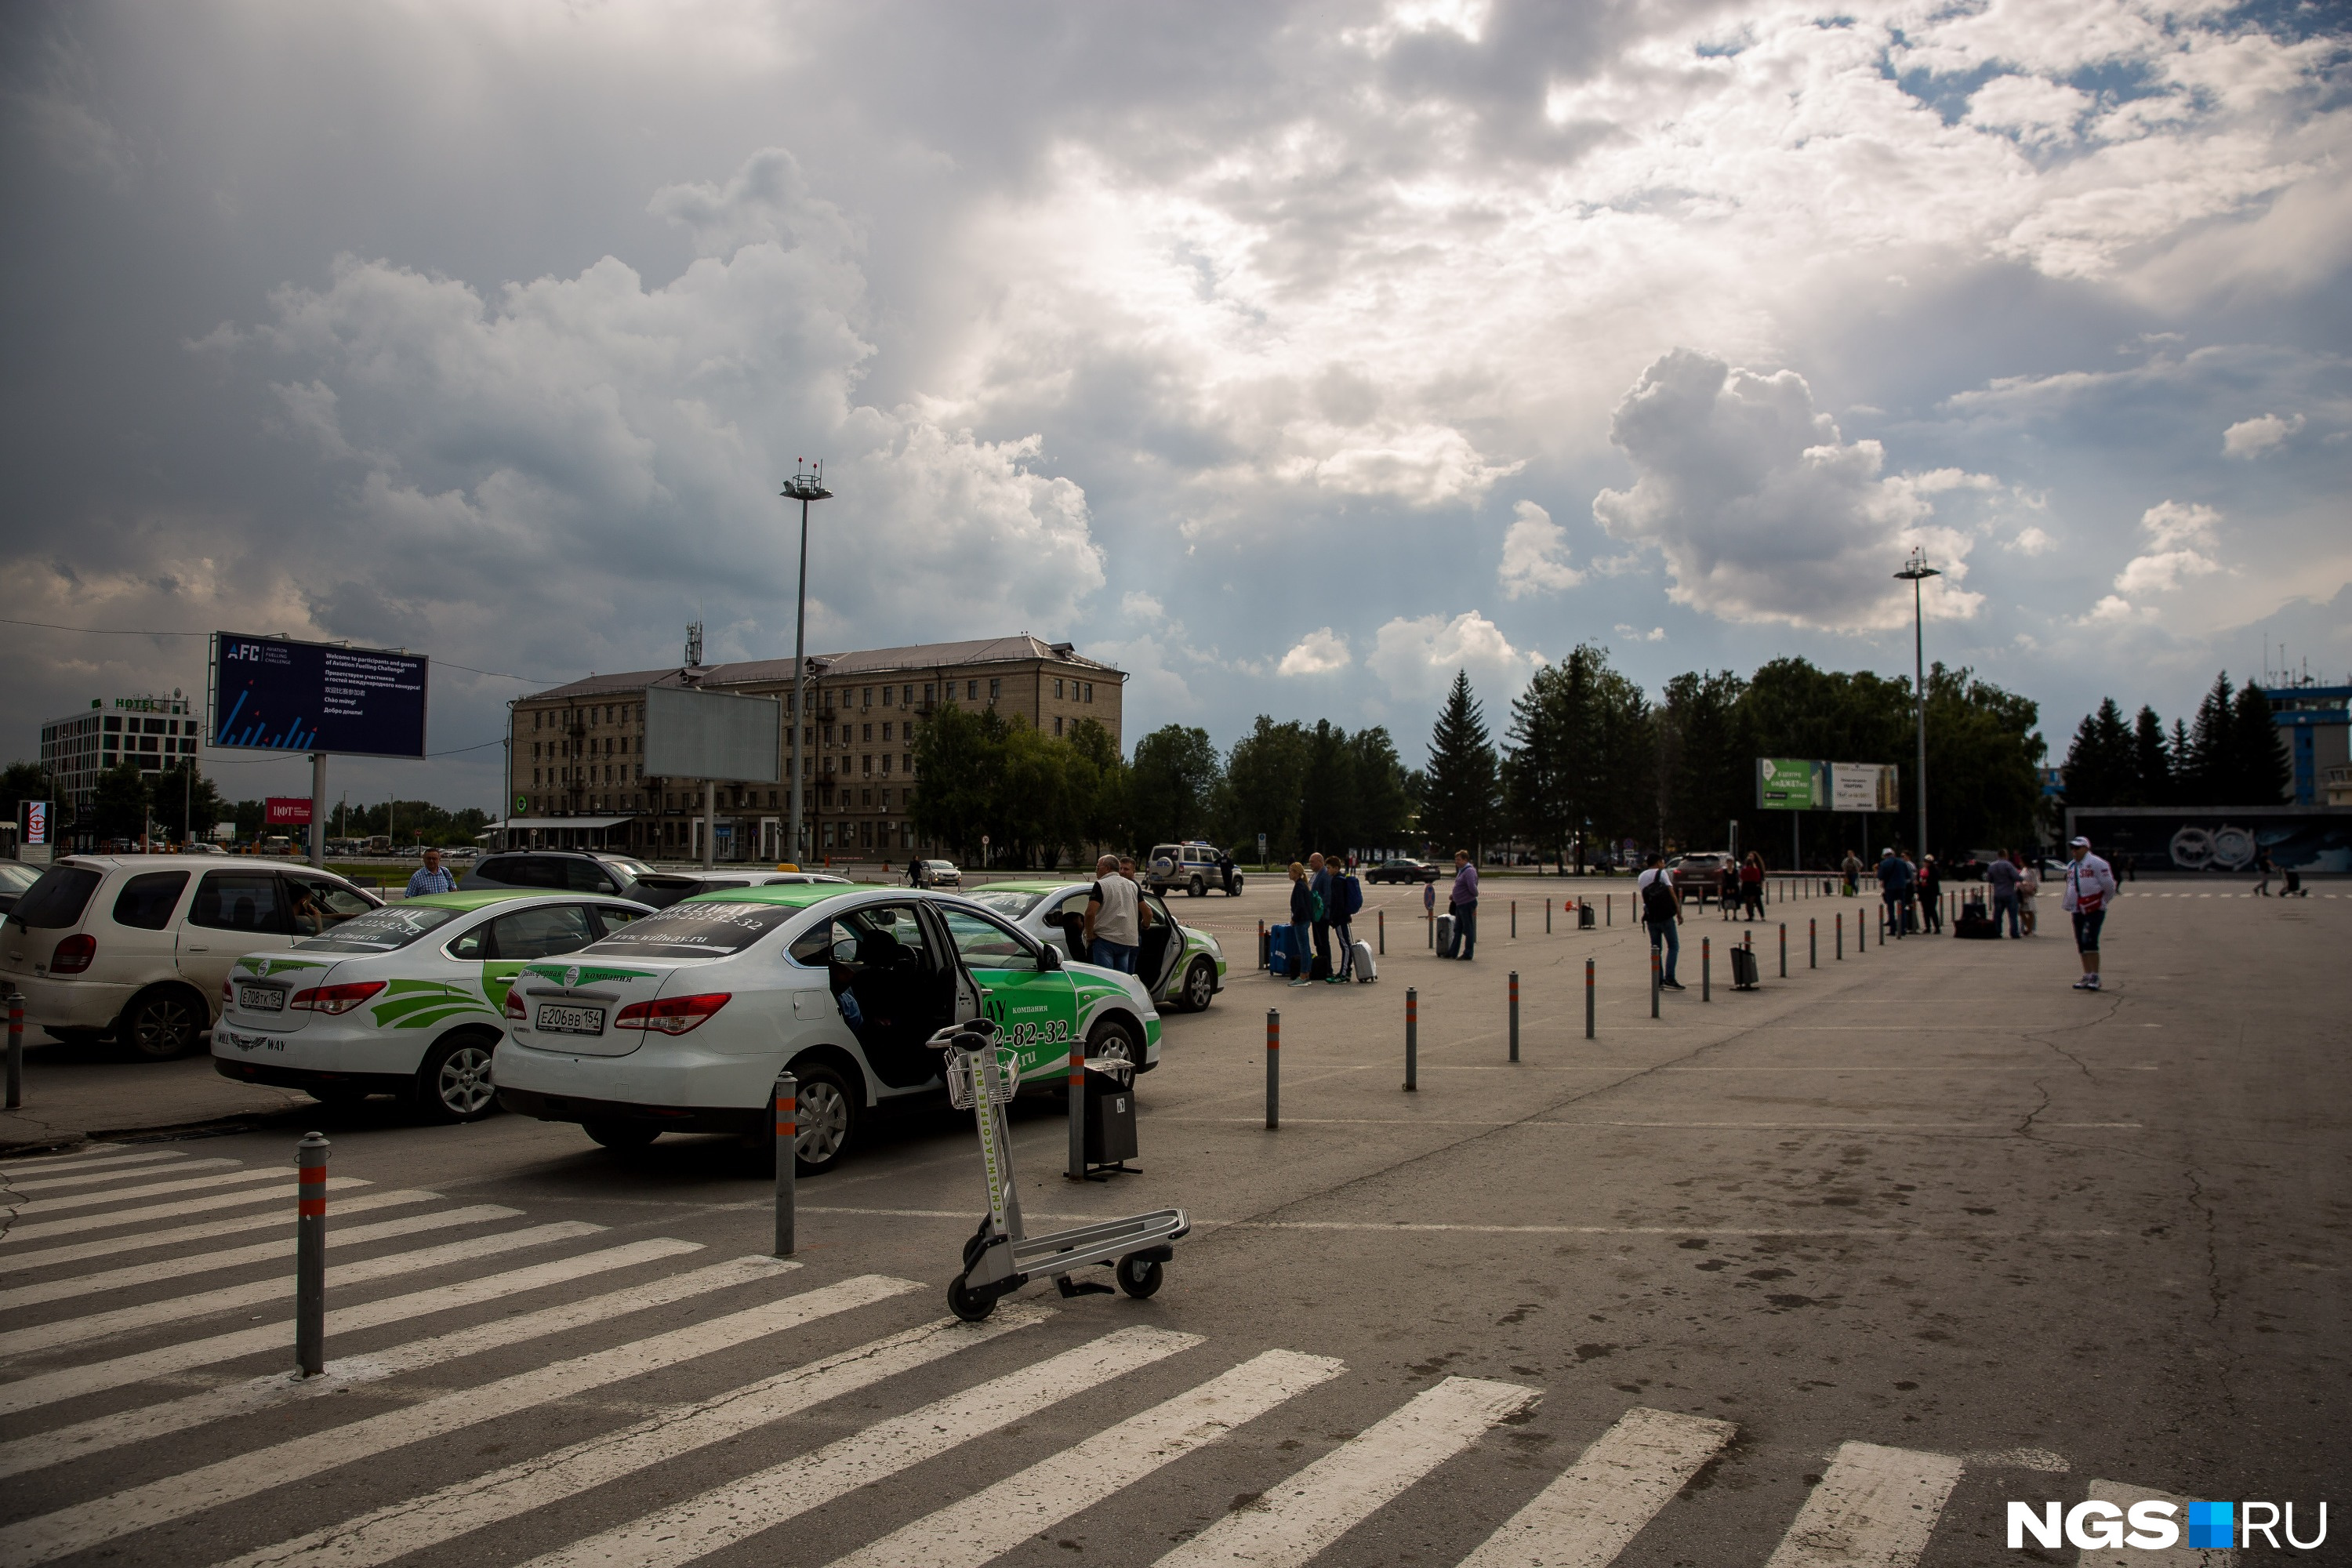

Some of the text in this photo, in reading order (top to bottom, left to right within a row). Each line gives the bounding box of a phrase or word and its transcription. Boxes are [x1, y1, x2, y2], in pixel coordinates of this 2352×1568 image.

[227, 643, 260, 661] AFC
[325, 670, 364, 679] Приветствуем
[348, 679, 394, 688] международного
[116, 699, 160, 710] HOTEL
[274, 806, 293, 817] ЦФТ
[270, 963, 305, 971] компания
[584, 971, 633, 983] компания
[270, 991, 281, 1003] 154
[1012, 1005, 1048, 1014] компания
[583, 1010, 600, 1024] 154
[218, 1033, 230, 1044] WILL
[994, 1020, 1069, 1048] 2-82-32
[267, 1039, 287, 1051] WAY
[975, 1069, 1002, 1211] CHASHKACOFFEE.RU
